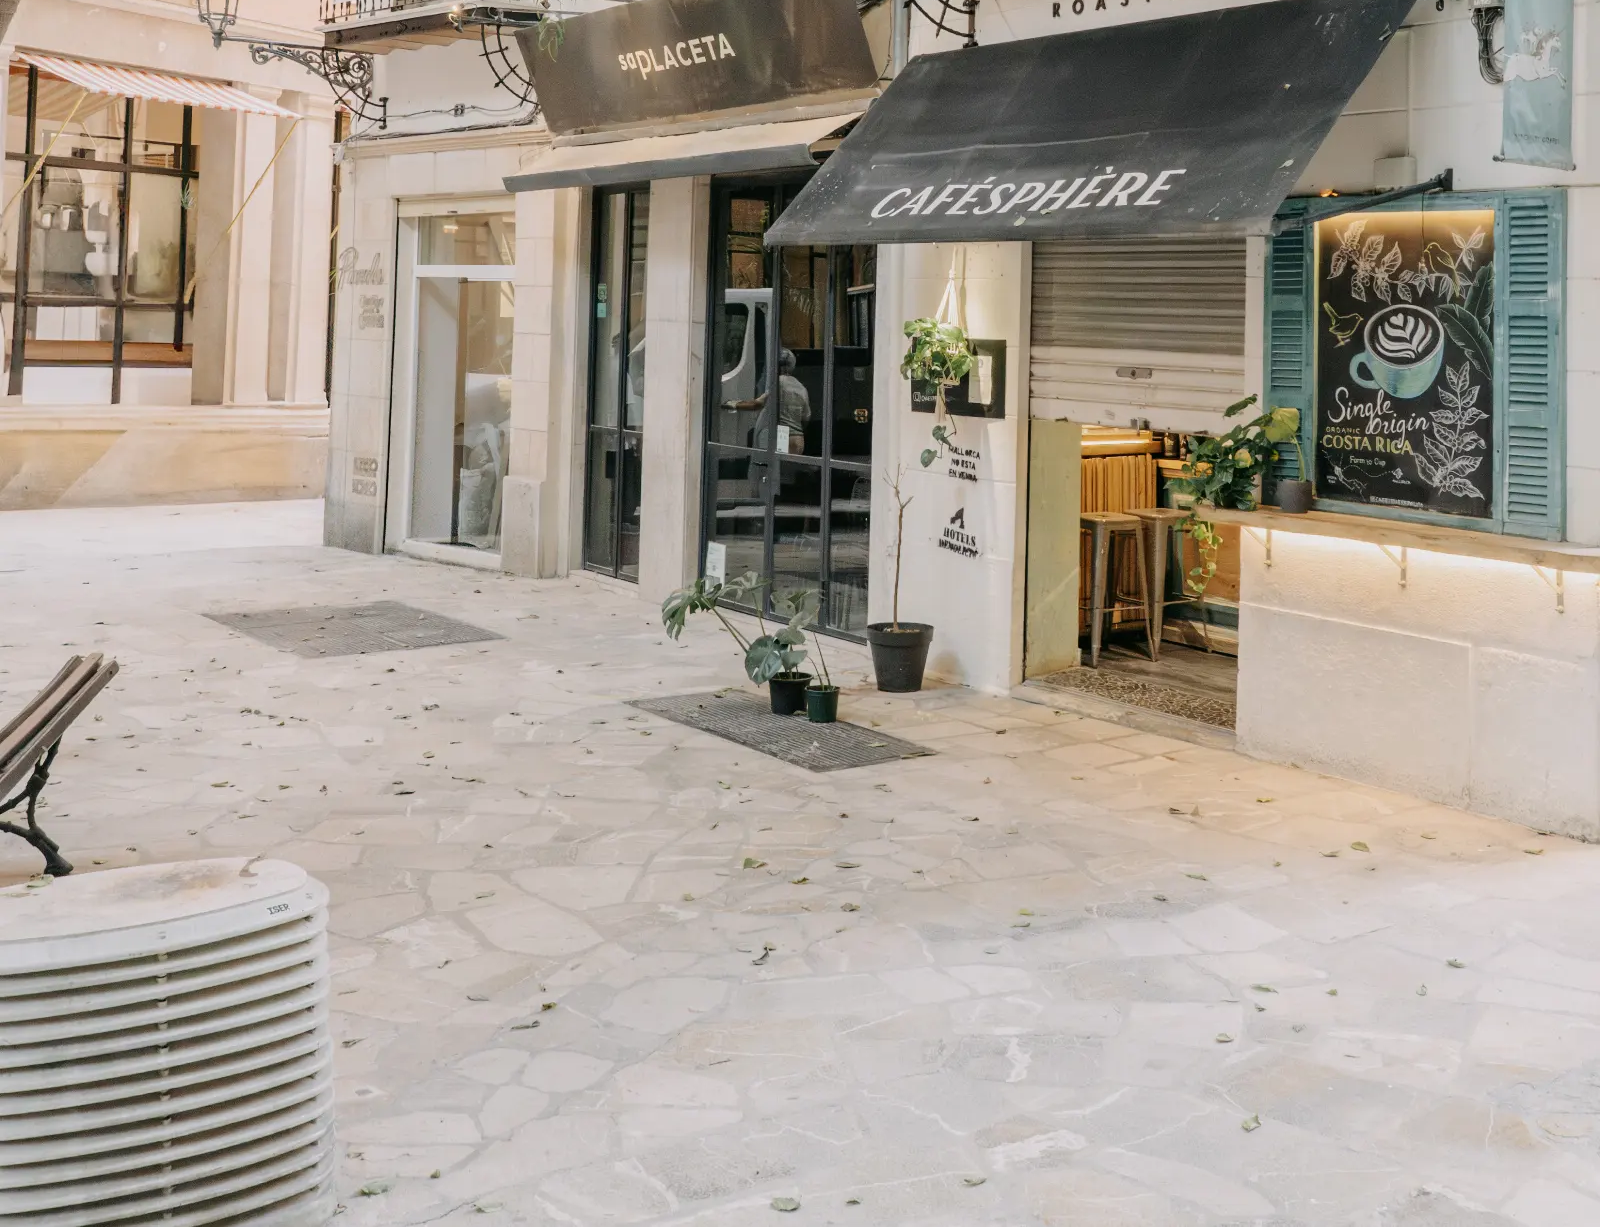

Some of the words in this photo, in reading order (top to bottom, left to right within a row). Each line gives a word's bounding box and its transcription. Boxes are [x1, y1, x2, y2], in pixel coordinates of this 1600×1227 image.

[1327, 386, 1394, 435] Single
[1325, 426, 1361, 434] ORGANIC
[1322, 434, 1372, 452] COSTA
[1375, 436, 1414, 456] RICA
[951, 458, 960, 467] NO
